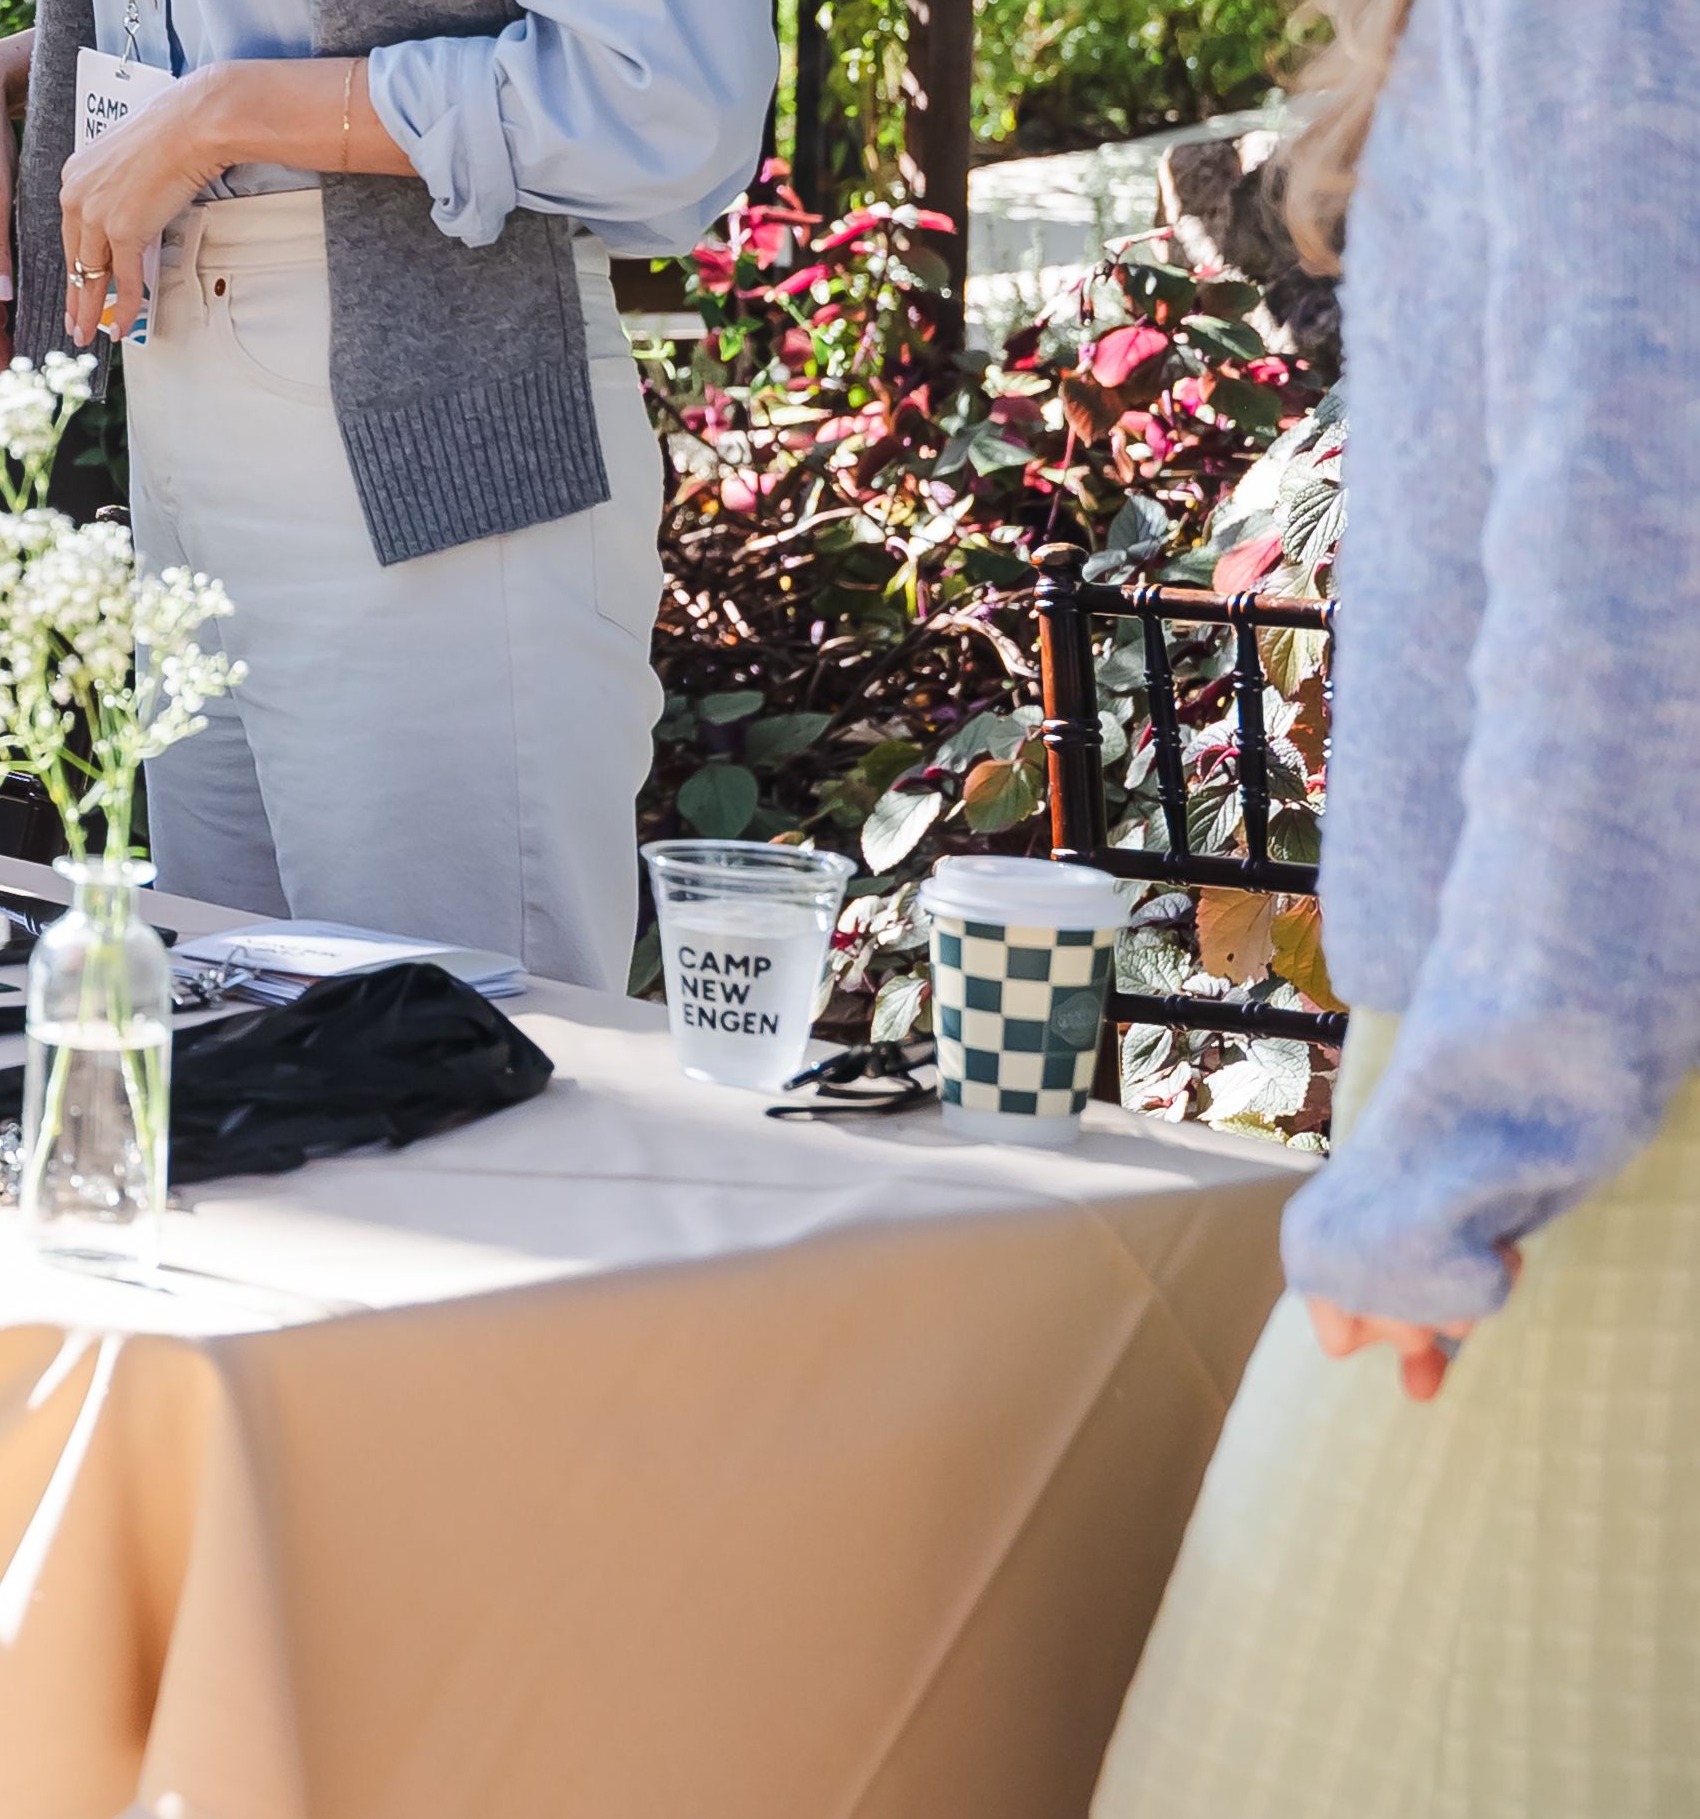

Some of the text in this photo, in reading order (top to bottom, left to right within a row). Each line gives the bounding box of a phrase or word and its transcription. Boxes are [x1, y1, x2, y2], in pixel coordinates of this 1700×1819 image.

[87, 93, 128, 121] CAMP
[679, 946, 772, 978] CAMP
[679, 974, 751, 1005] NEW
[683, 1004, 780, 1035] ENGEN
